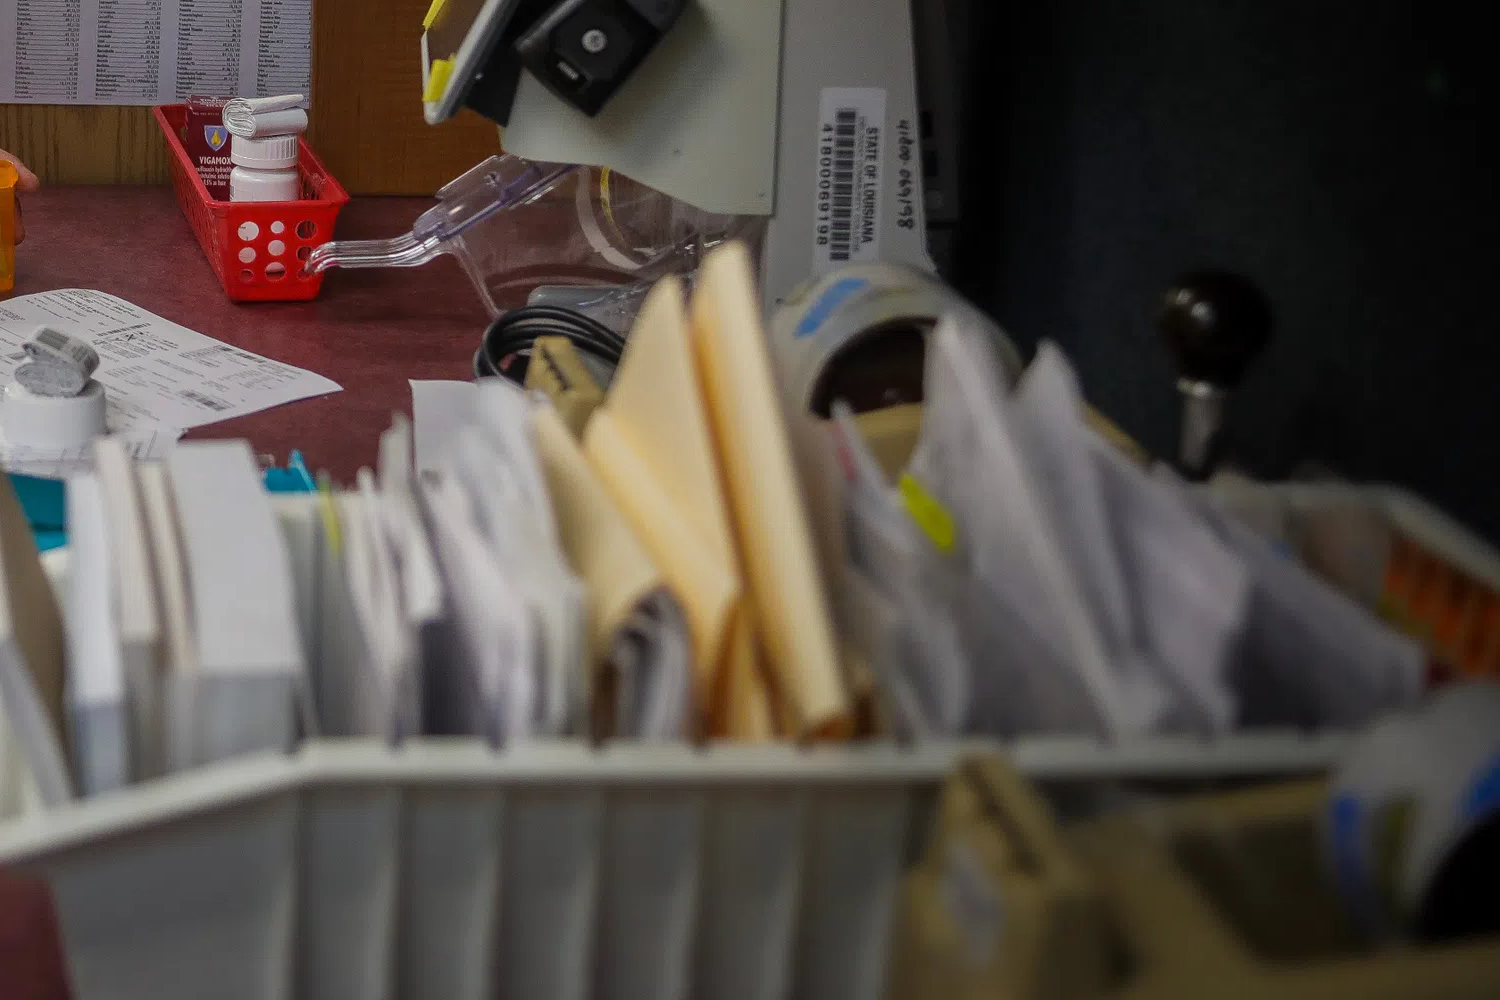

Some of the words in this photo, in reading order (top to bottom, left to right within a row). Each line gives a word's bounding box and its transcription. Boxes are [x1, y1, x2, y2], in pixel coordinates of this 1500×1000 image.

[866, 126, 879, 162] STATE
[200, 156, 232, 165] VIGAMOX
[864, 165, 877, 180] OF
[862, 183, 876, 244] LOUISIANA
